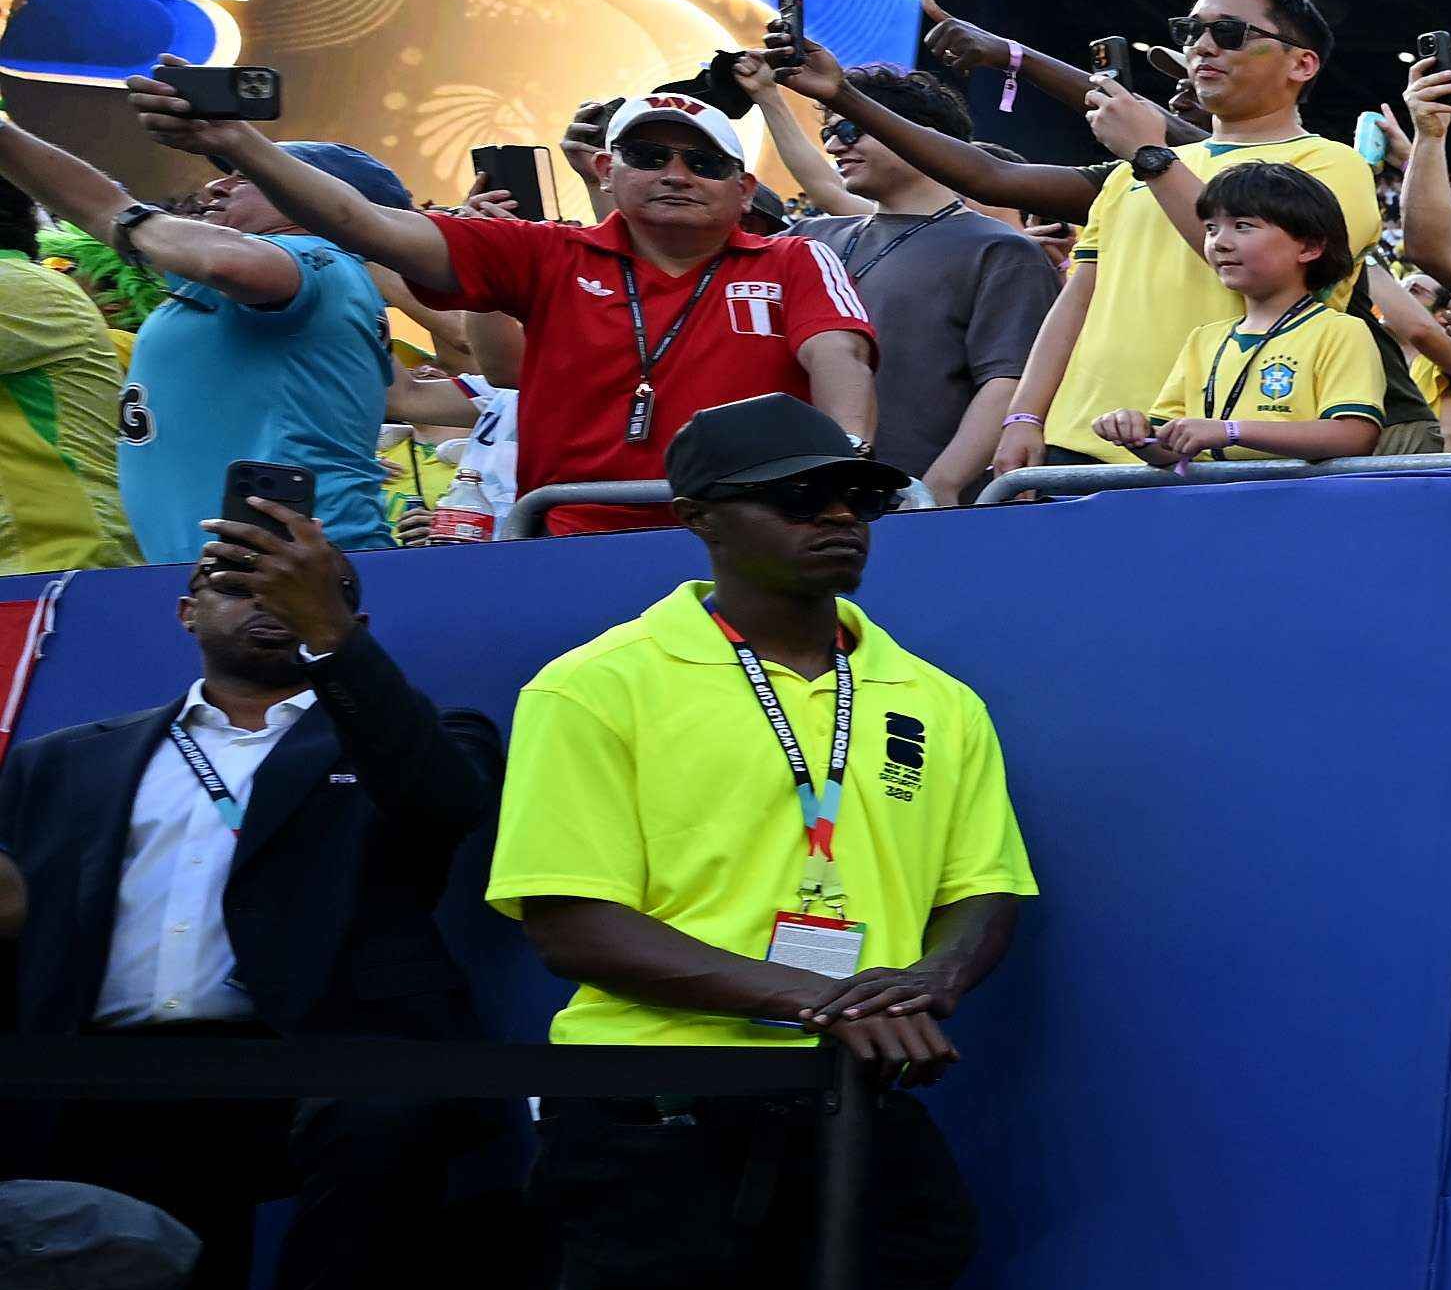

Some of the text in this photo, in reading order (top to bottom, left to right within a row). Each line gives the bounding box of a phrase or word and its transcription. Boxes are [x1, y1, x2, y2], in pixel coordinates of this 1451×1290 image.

[732, 284, 779, 297] FPF
[1257, 404, 1292, 413] BRASIL
[755, 684, 778, 707] CUP
[838, 672, 851, 706] WORLD
[766, 707, 796, 746] WORLD
[837, 709, 850, 729] CUP
[785, 749, 807, 771] FIFA
